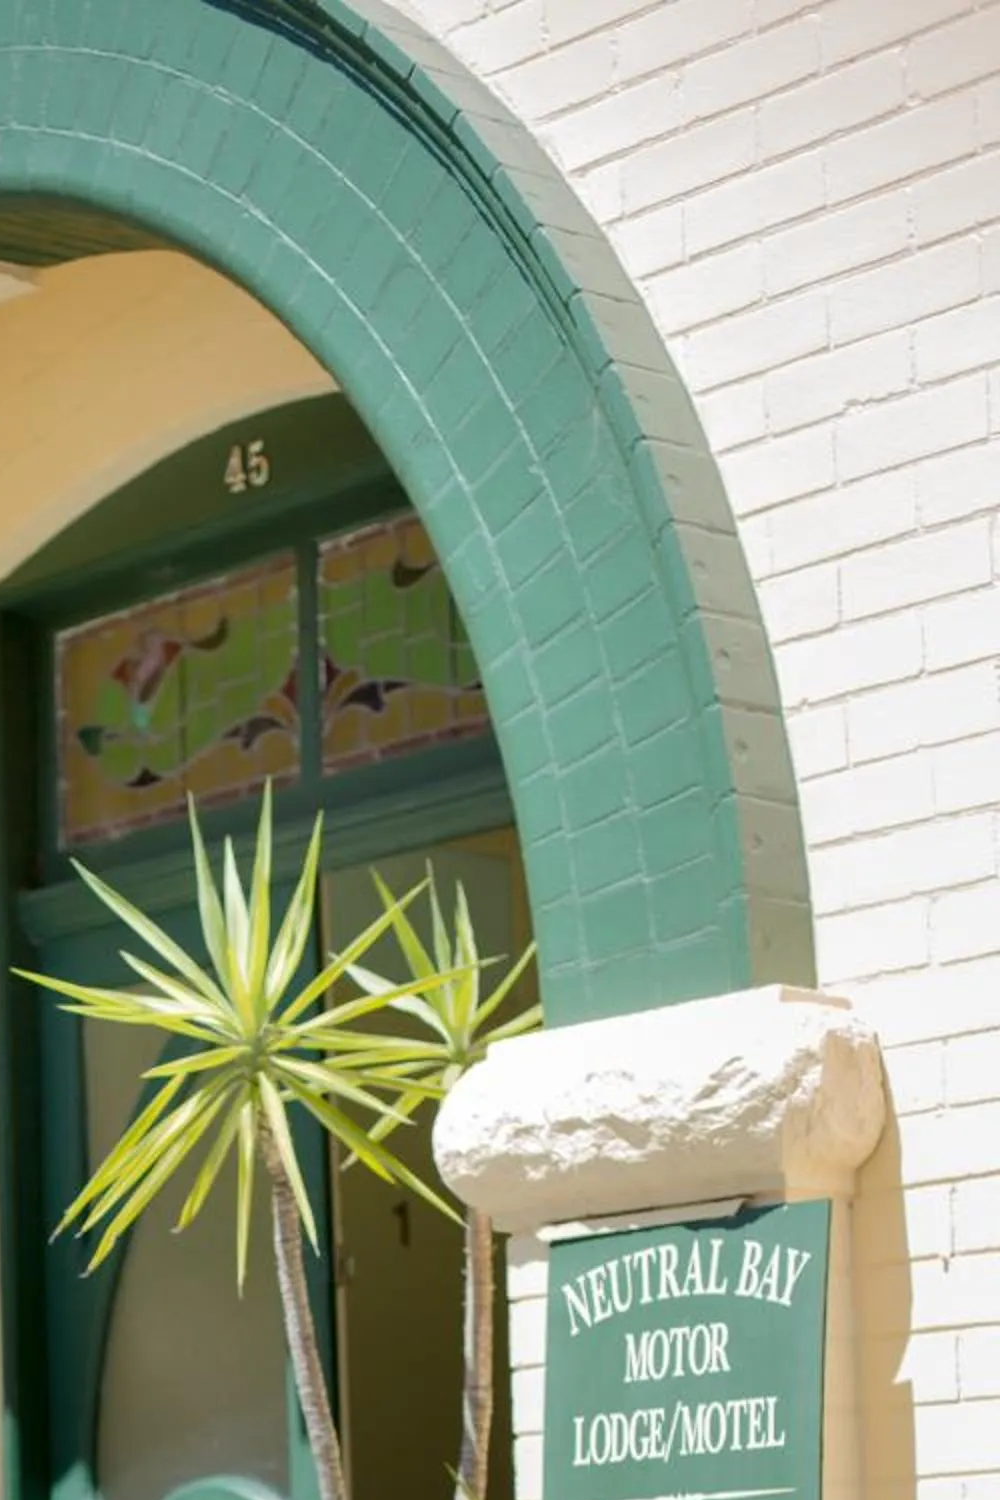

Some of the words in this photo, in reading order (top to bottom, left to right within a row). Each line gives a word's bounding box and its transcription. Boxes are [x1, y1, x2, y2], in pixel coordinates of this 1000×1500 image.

[223, 439, 270, 494] 45
[561, 1237, 728, 1336] NEUTRAL
[735, 1239, 812, 1307] BAY
[623, 1322, 732, 1383] MOTOR
[573, 1396, 786, 1467] LODGE/MOTEL
